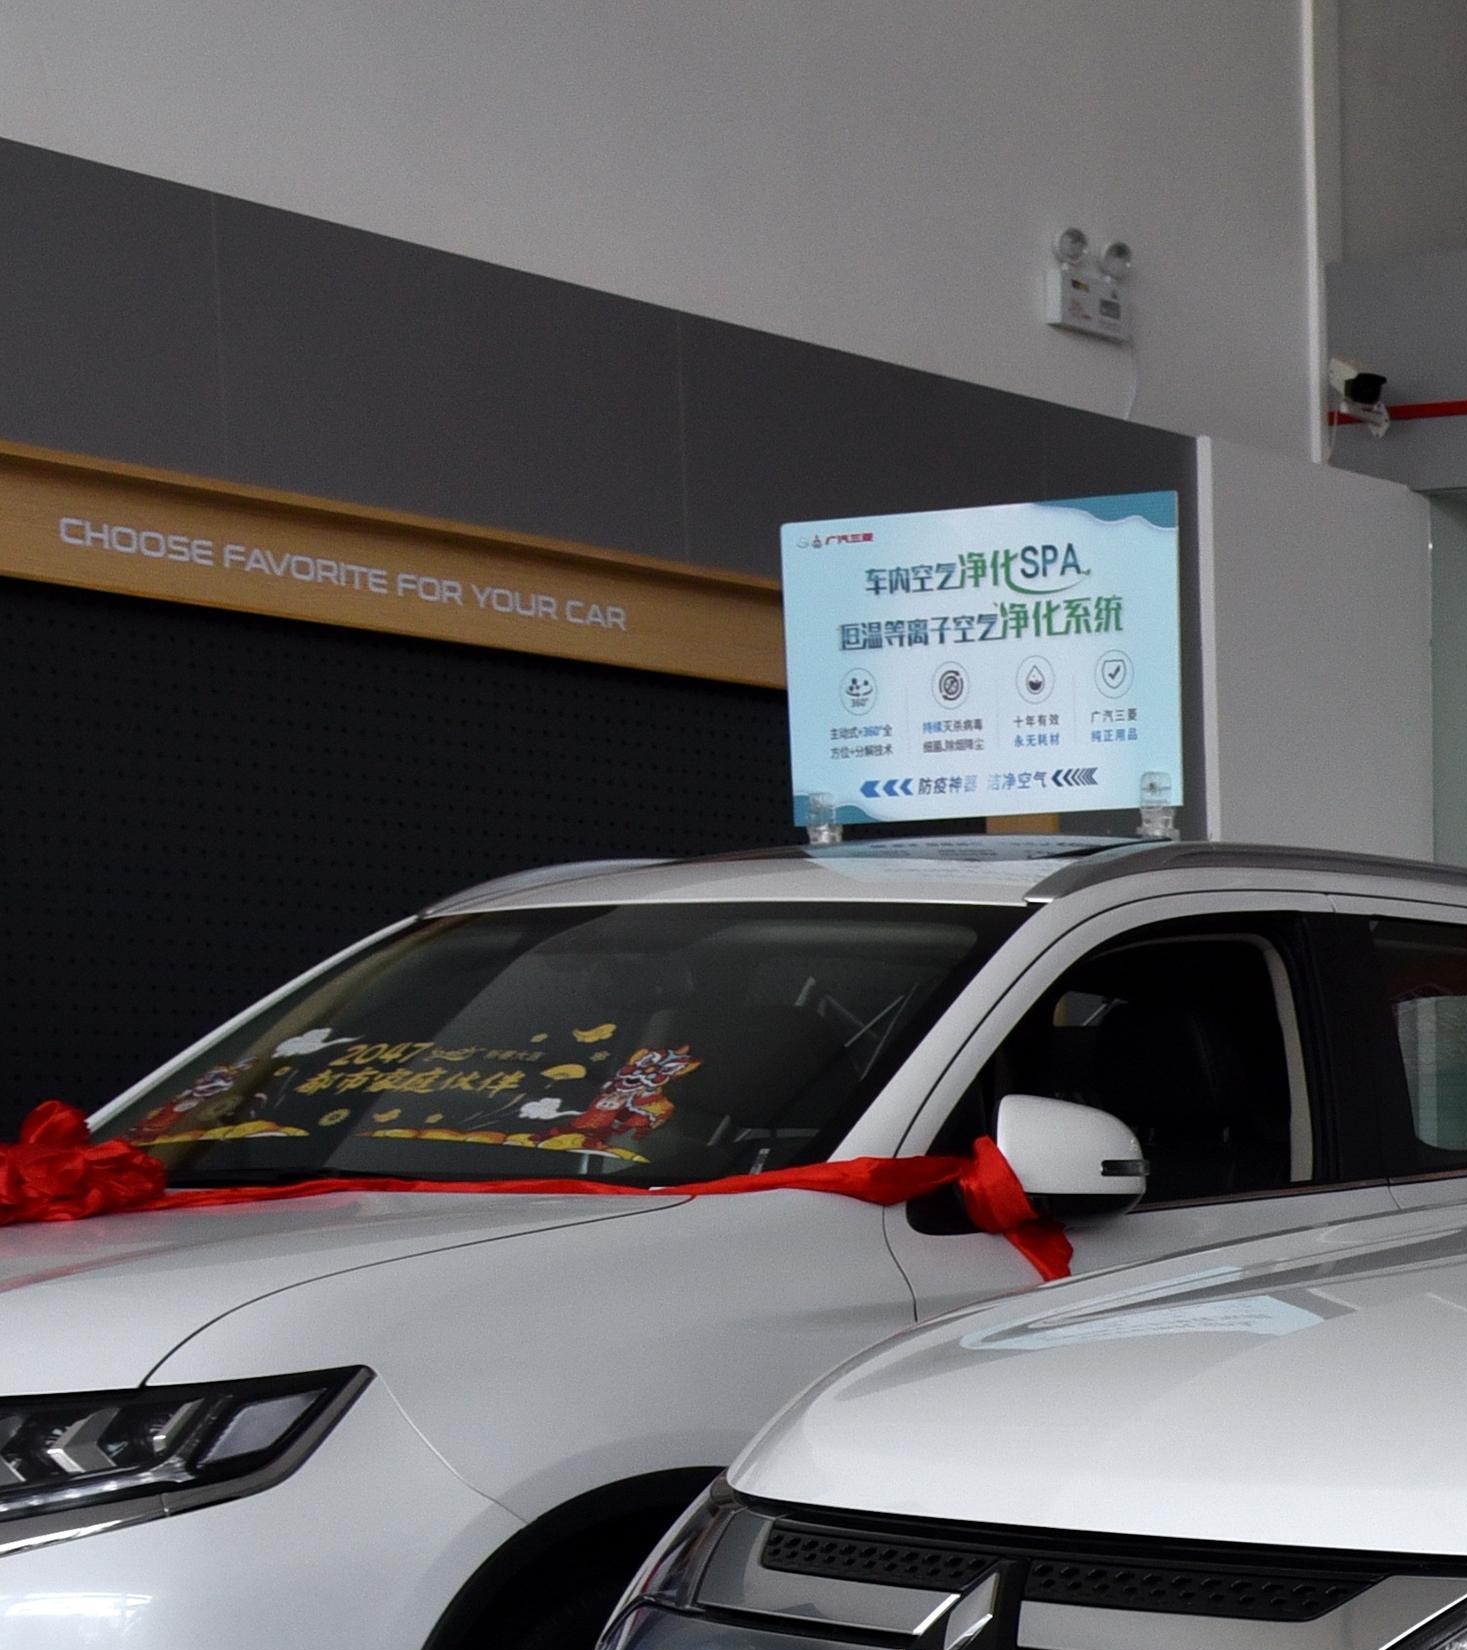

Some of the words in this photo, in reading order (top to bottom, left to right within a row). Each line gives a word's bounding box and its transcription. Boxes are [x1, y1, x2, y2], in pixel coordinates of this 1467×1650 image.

[59, 517, 213, 567] CHOOSE
[223, 544, 388, 595] FAVORITE
[397, 574, 463, 607] FOR
[471, 584, 558, 620] YOUR
[565, 601, 627, 631] CAR
[838, 595, 1123, 651] 恒温等离子空气净化系统
[1013, 713, 1060, 728] 十年有效
[1090, 708, 1138, 724] 广汽三菱
